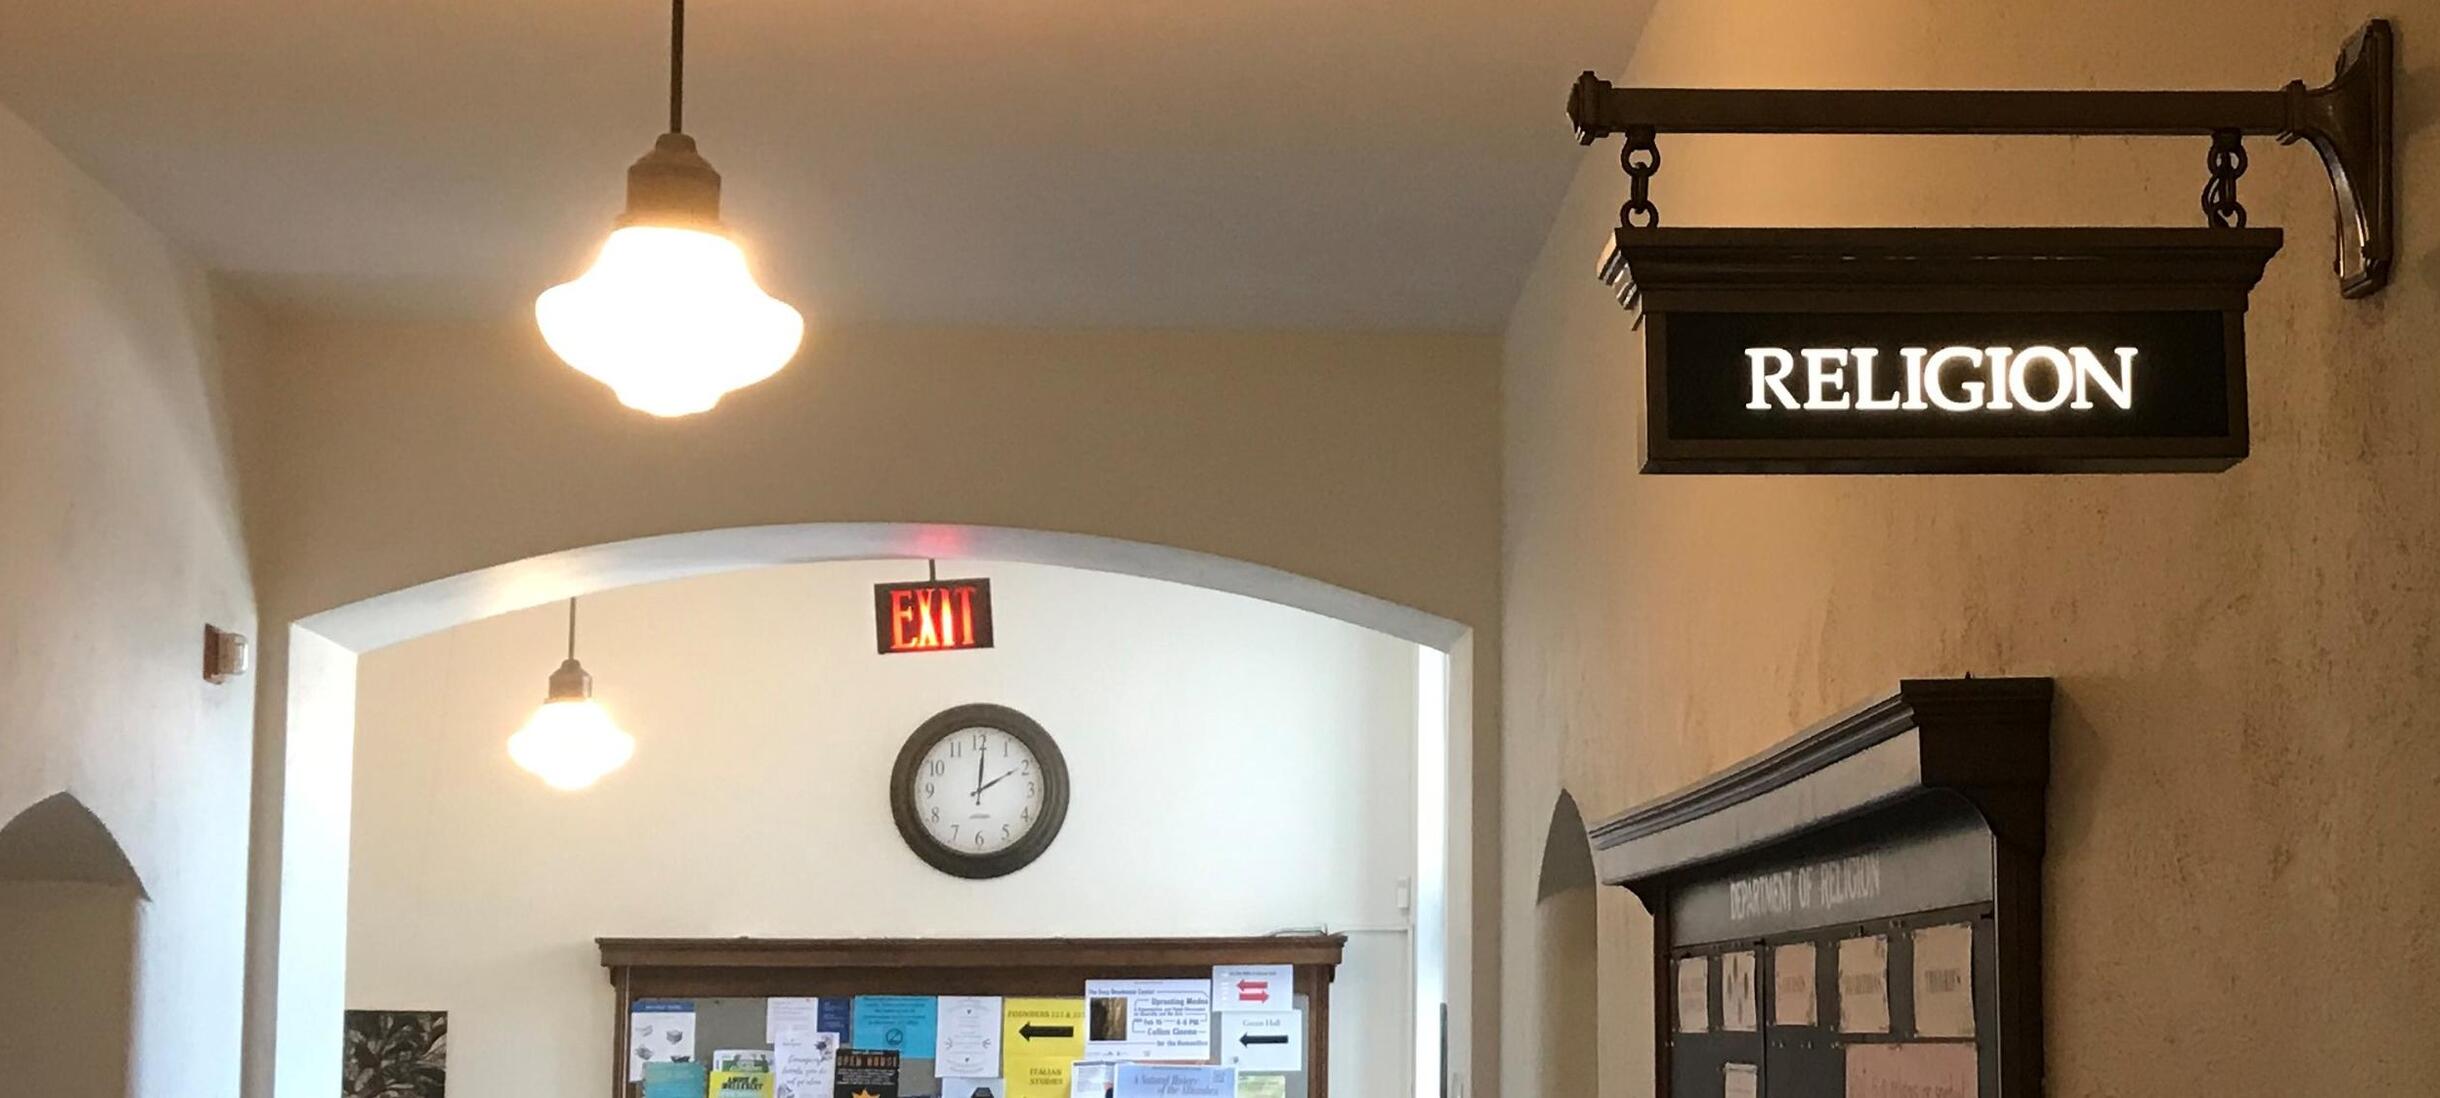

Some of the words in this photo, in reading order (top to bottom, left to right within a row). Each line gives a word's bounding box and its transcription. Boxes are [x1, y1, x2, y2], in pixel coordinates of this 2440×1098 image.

[1745, 345, 2139, 412] RELIGION
[889, 586, 977, 649] EXIT
[950, 741, 962, 758] 11
[973, 734, 987, 751] 12
[1003, 741, 1009, 758] 1
[929, 760, 945, 777] 10
[1020, 759, 1030, 776] 2
[925, 782, 935, 799] 9
[1027, 781, 1035, 799] 3
[931, 806, 940, 823] 8
[1020, 806, 1029, 823] 4
[950, 824, 960, 841] 7
[975, 831, 985, 847] 6
[1002, 823, 1010, 840] 5
[1730, 871, 1792, 920] DEPARTMENT
[1799, 866, 1813, 909] OF
[1821, 851, 1880, 910] RELIGION
[1265, 1018, 1281, 1027] Hall
[837, 1055, 863, 1067] OPEN
[866, 1055, 897, 1067] HOUSE
[1030, 1068, 1062, 1076] ITALIAN
[1030, 1078, 1063, 1086] STUDIES
